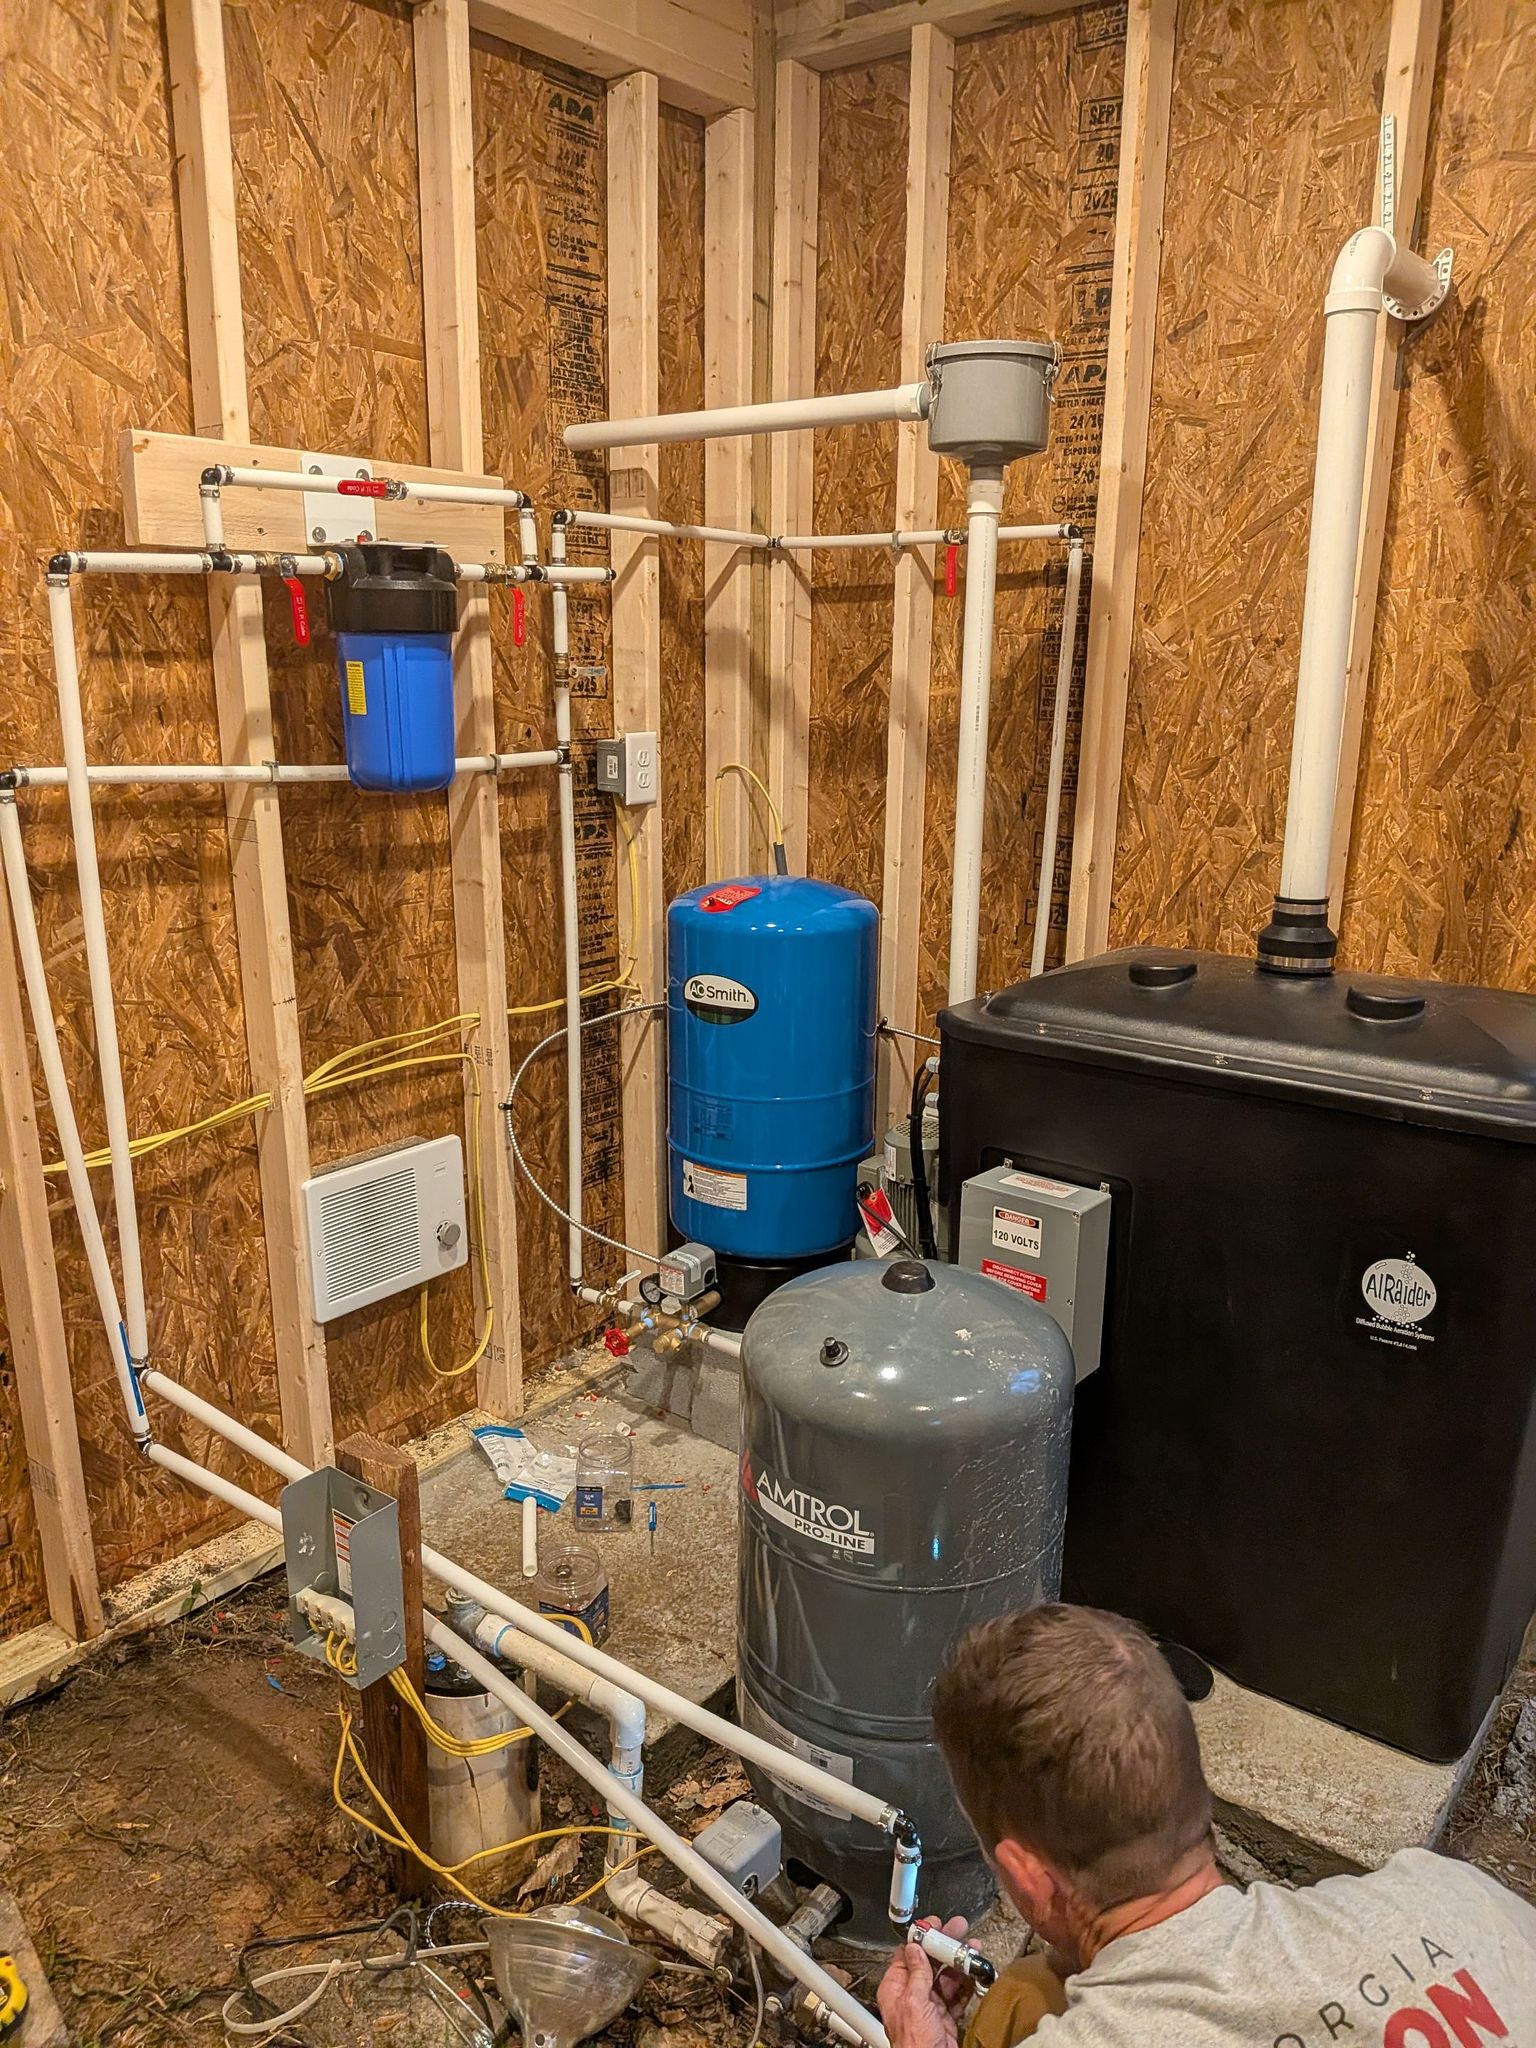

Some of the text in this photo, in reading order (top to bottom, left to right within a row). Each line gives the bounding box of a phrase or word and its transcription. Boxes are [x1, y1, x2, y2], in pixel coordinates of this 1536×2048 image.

[548, 92, 594, 125] APA
[1089, 102, 1123, 125] SEPT
[1004, 1212, 1030, 1225] DANGER
[994, 1229, 1039, 1251] 120 VOLTS
[1026, 1280, 1042, 1289] COVER
[1376, 1322, 1393, 1332] Bubble
[1393, 1326, 1415, 1337] Aeration
[1414, 1331, 1435, 1342] Systems
[756, 1469, 870, 1537] AMTROL
[794, 1517, 866, 1550] PRO-LINE
